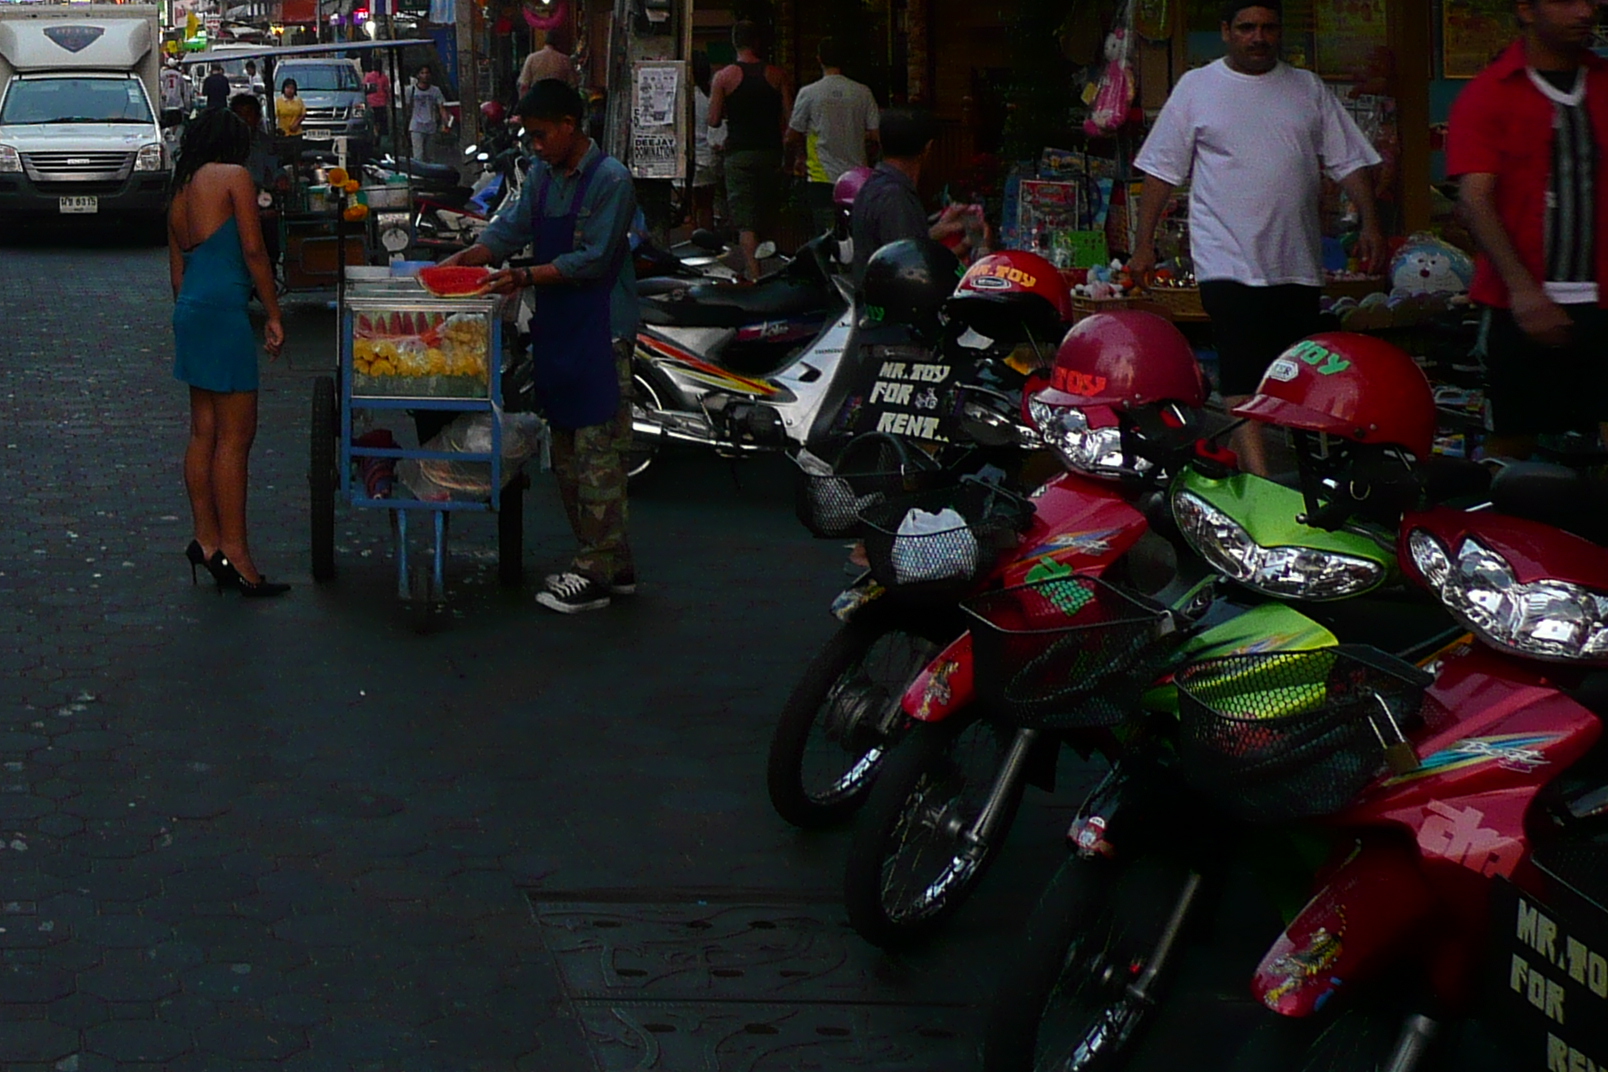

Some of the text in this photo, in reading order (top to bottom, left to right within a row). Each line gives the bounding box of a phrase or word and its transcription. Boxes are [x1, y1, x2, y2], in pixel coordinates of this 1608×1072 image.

[635, 139, 674, 147] DEEJAY
[868, 380, 915, 406] FOR
[1509, 951, 1567, 1026] FOR
